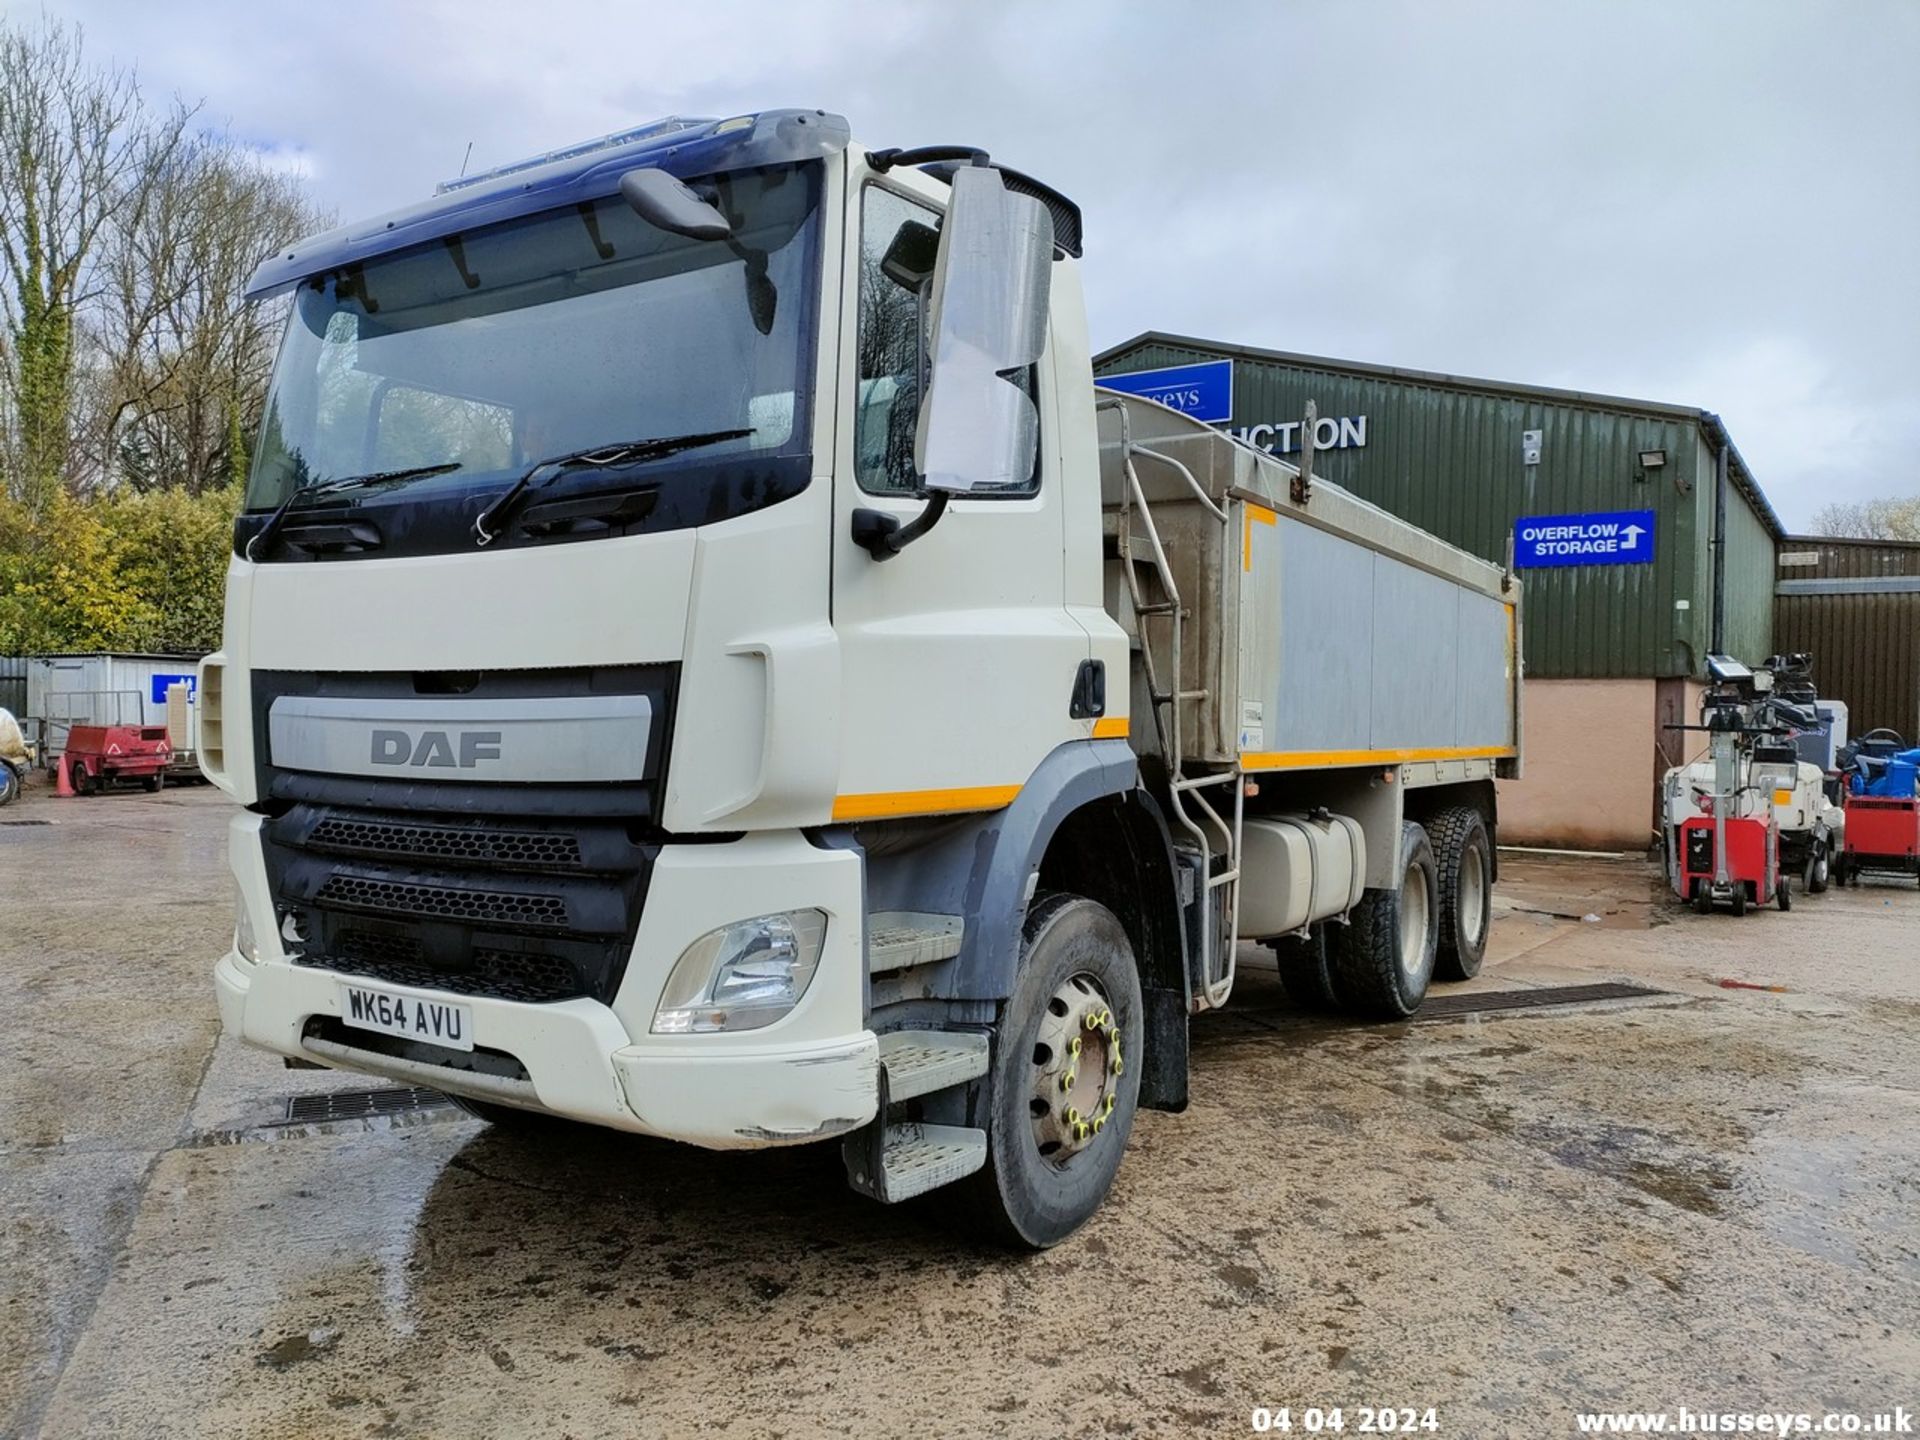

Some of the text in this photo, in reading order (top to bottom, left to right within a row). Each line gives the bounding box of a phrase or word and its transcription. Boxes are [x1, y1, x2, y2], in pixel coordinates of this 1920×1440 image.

[1146, 389, 1200, 411] seys
[1522, 524, 1619, 541] OVERFLOW
[1535, 540, 1618, 556] STORAGE
[371, 730, 502, 768] DAF
[349, 988, 462, 1040] WK64 AVU
